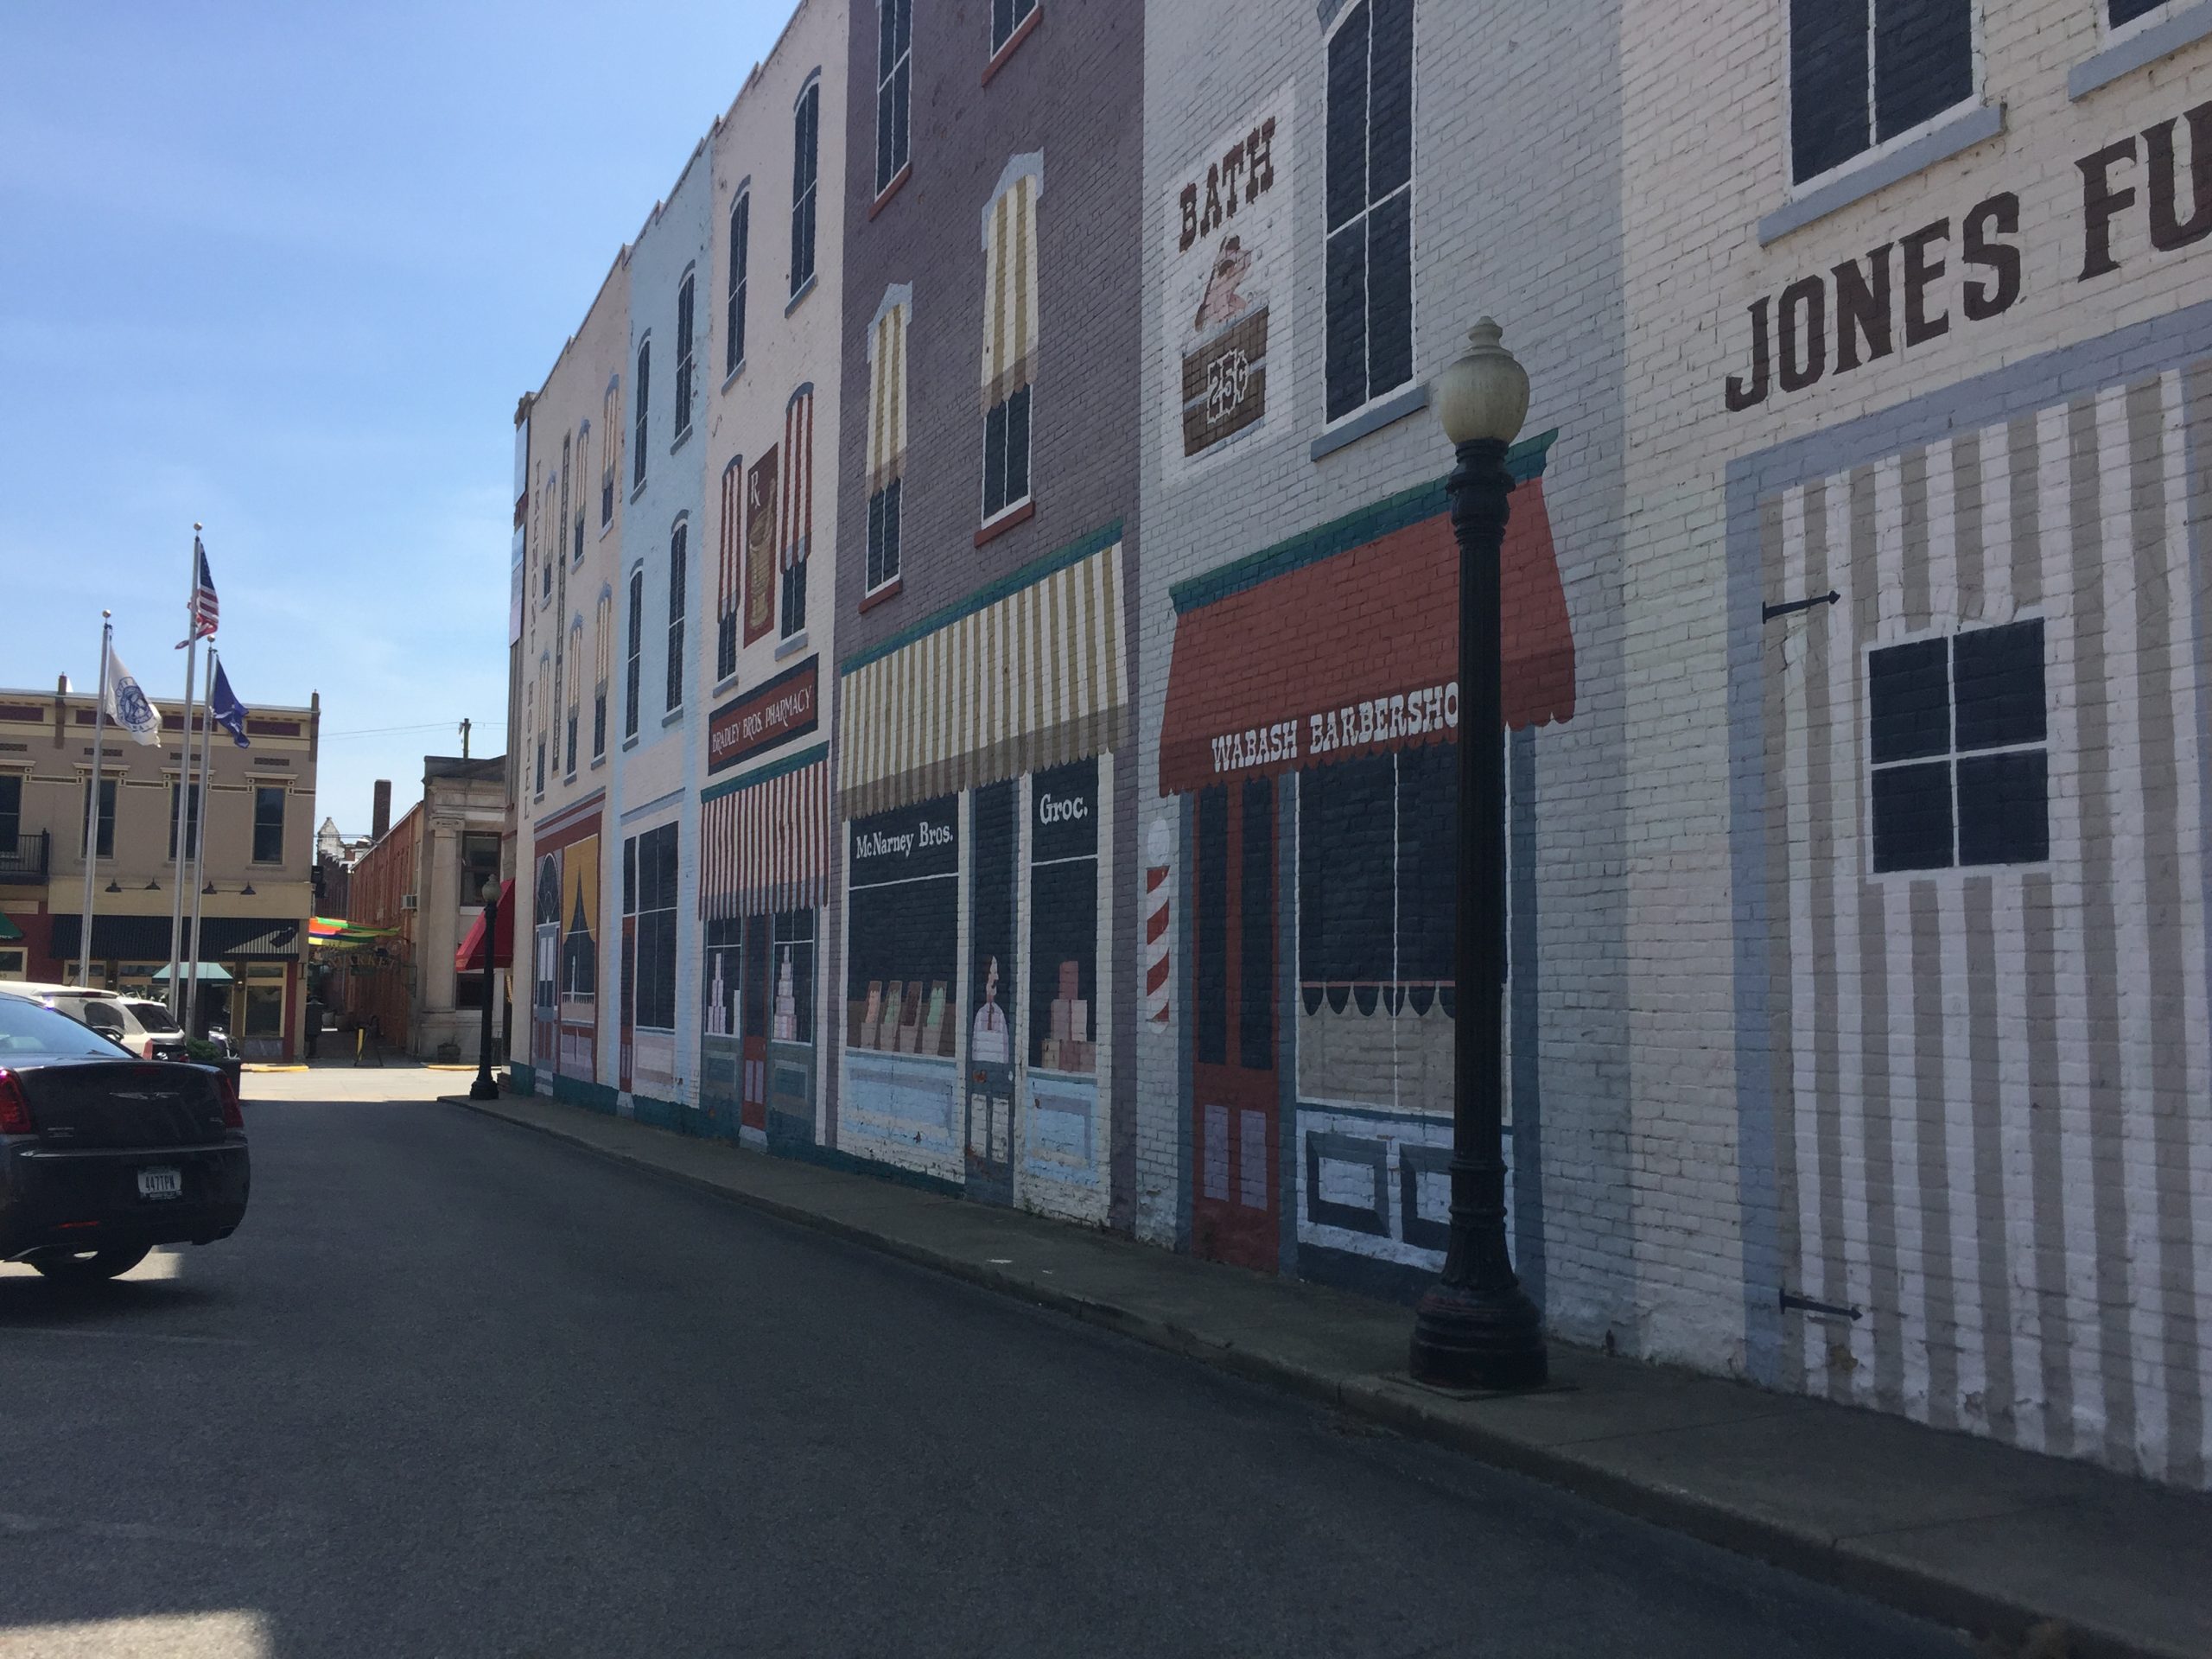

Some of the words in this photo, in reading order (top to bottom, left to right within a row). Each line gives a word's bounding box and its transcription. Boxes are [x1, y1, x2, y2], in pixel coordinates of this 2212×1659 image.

[1179, 116, 1276, 254] BATH
[1726, 191, 2021, 412] JONES
[2075, 100, 2212, 283] FU
[530, 458, 542, 655] TREMONT
[524, 681, 535, 821] HOTEL
[711, 721, 741, 756] BRADLEY
[766, 684, 812, 728] PHARMACY
[1211, 719, 1298, 773] WABASH
[1309, 681, 1459, 755] BARBERSHO
[918, 821, 954, 848] Bros.
[1039, 792, 1089, 825] Groc.
